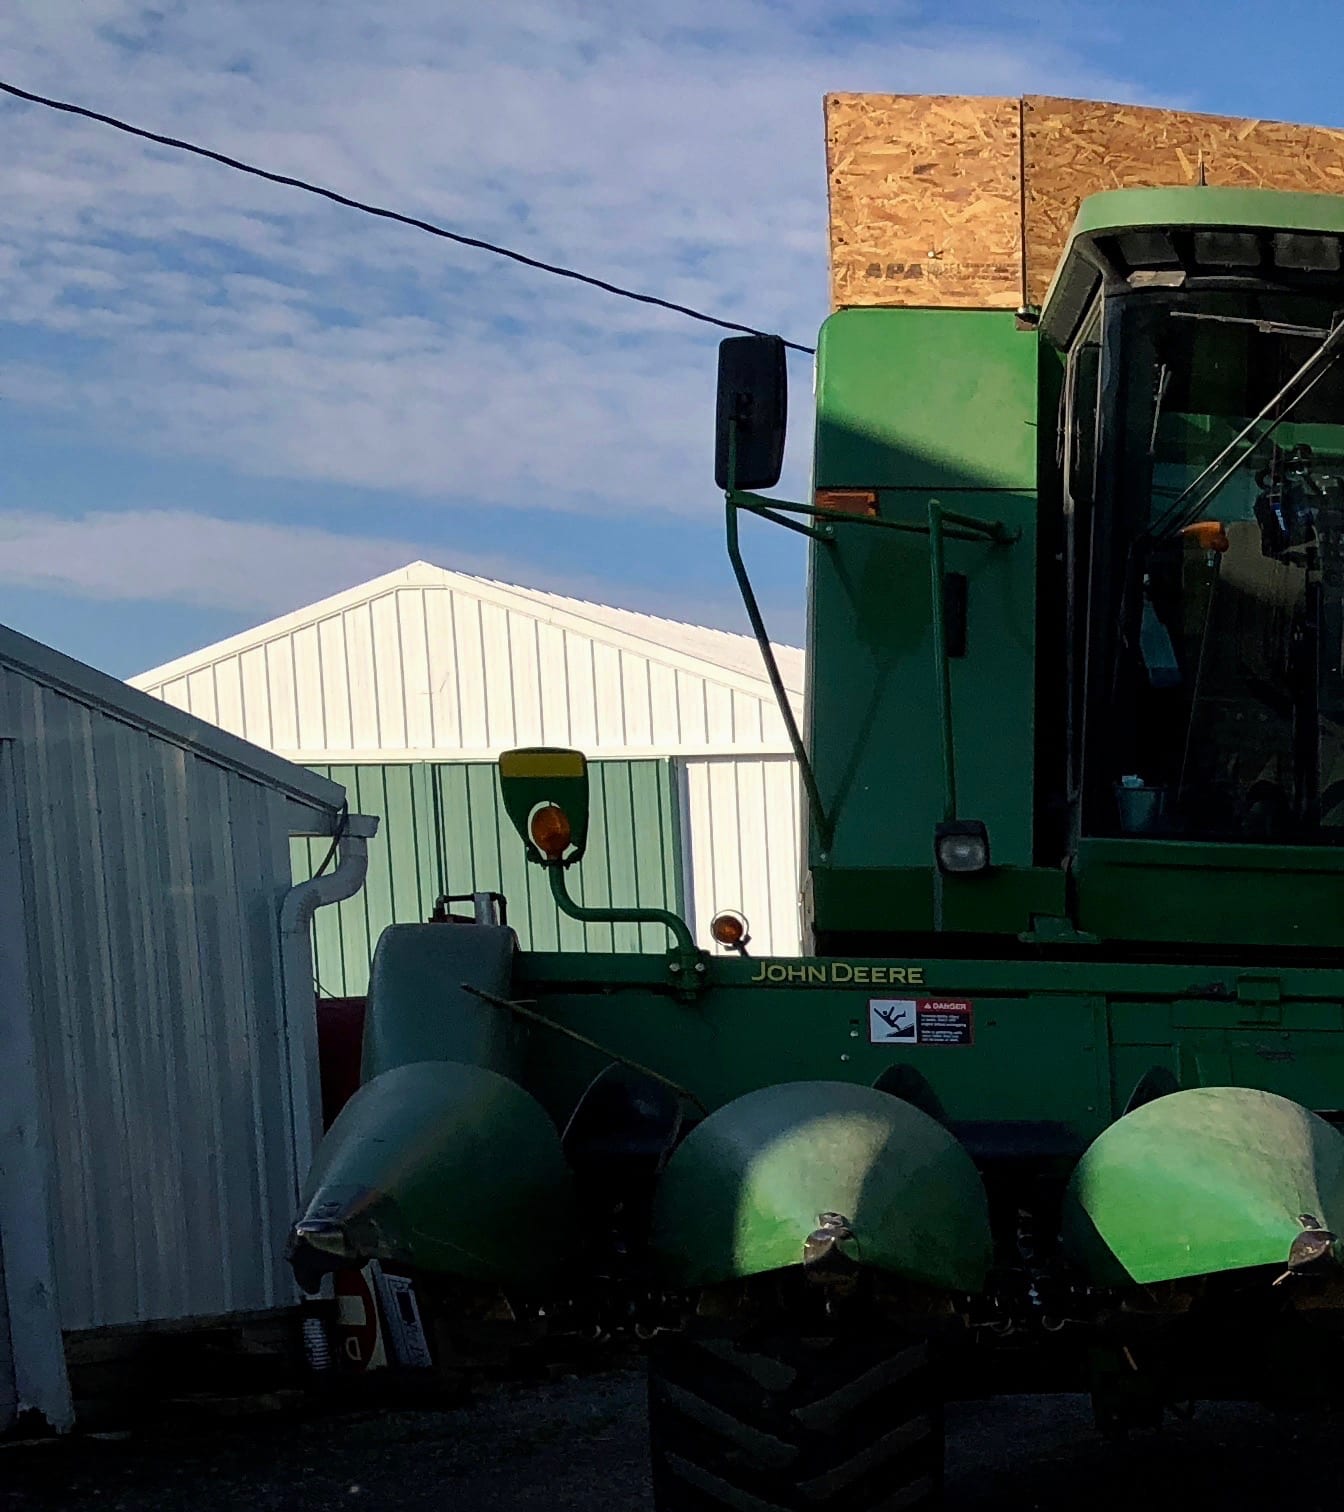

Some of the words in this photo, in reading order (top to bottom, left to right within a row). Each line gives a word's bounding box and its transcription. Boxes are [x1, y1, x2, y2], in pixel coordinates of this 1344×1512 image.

[751, 961, 826, 982] JOHN
[831, 962, 924, 984] DEERE
[933, 1002, 967, 1010] DANGER
